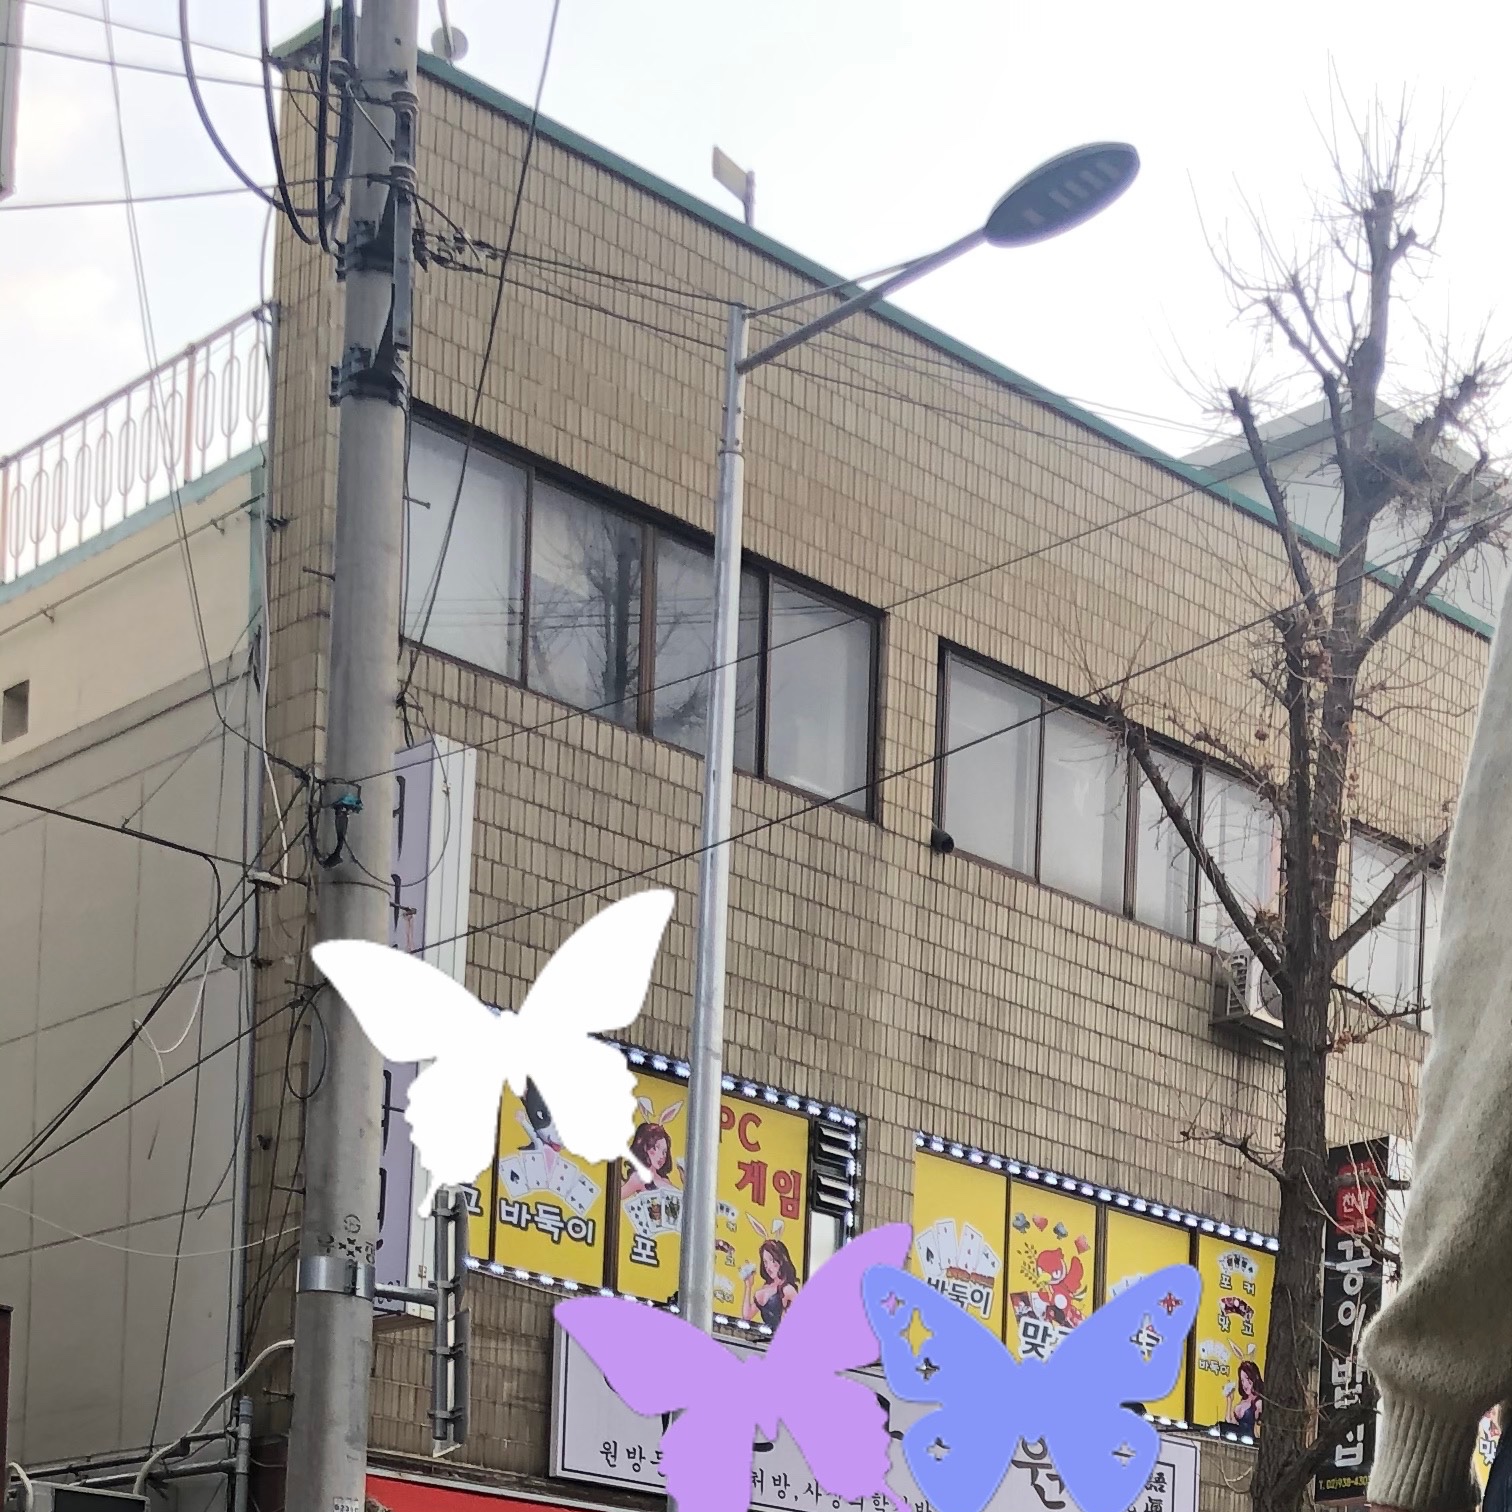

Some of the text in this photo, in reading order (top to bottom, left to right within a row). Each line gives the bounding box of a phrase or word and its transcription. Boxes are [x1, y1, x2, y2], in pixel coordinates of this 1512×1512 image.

[735, 1160, 802, 1220] 게임
[500, 1198, 596, 1246] 바둑이
[1022, 1321, 1071, 1359] 맞
